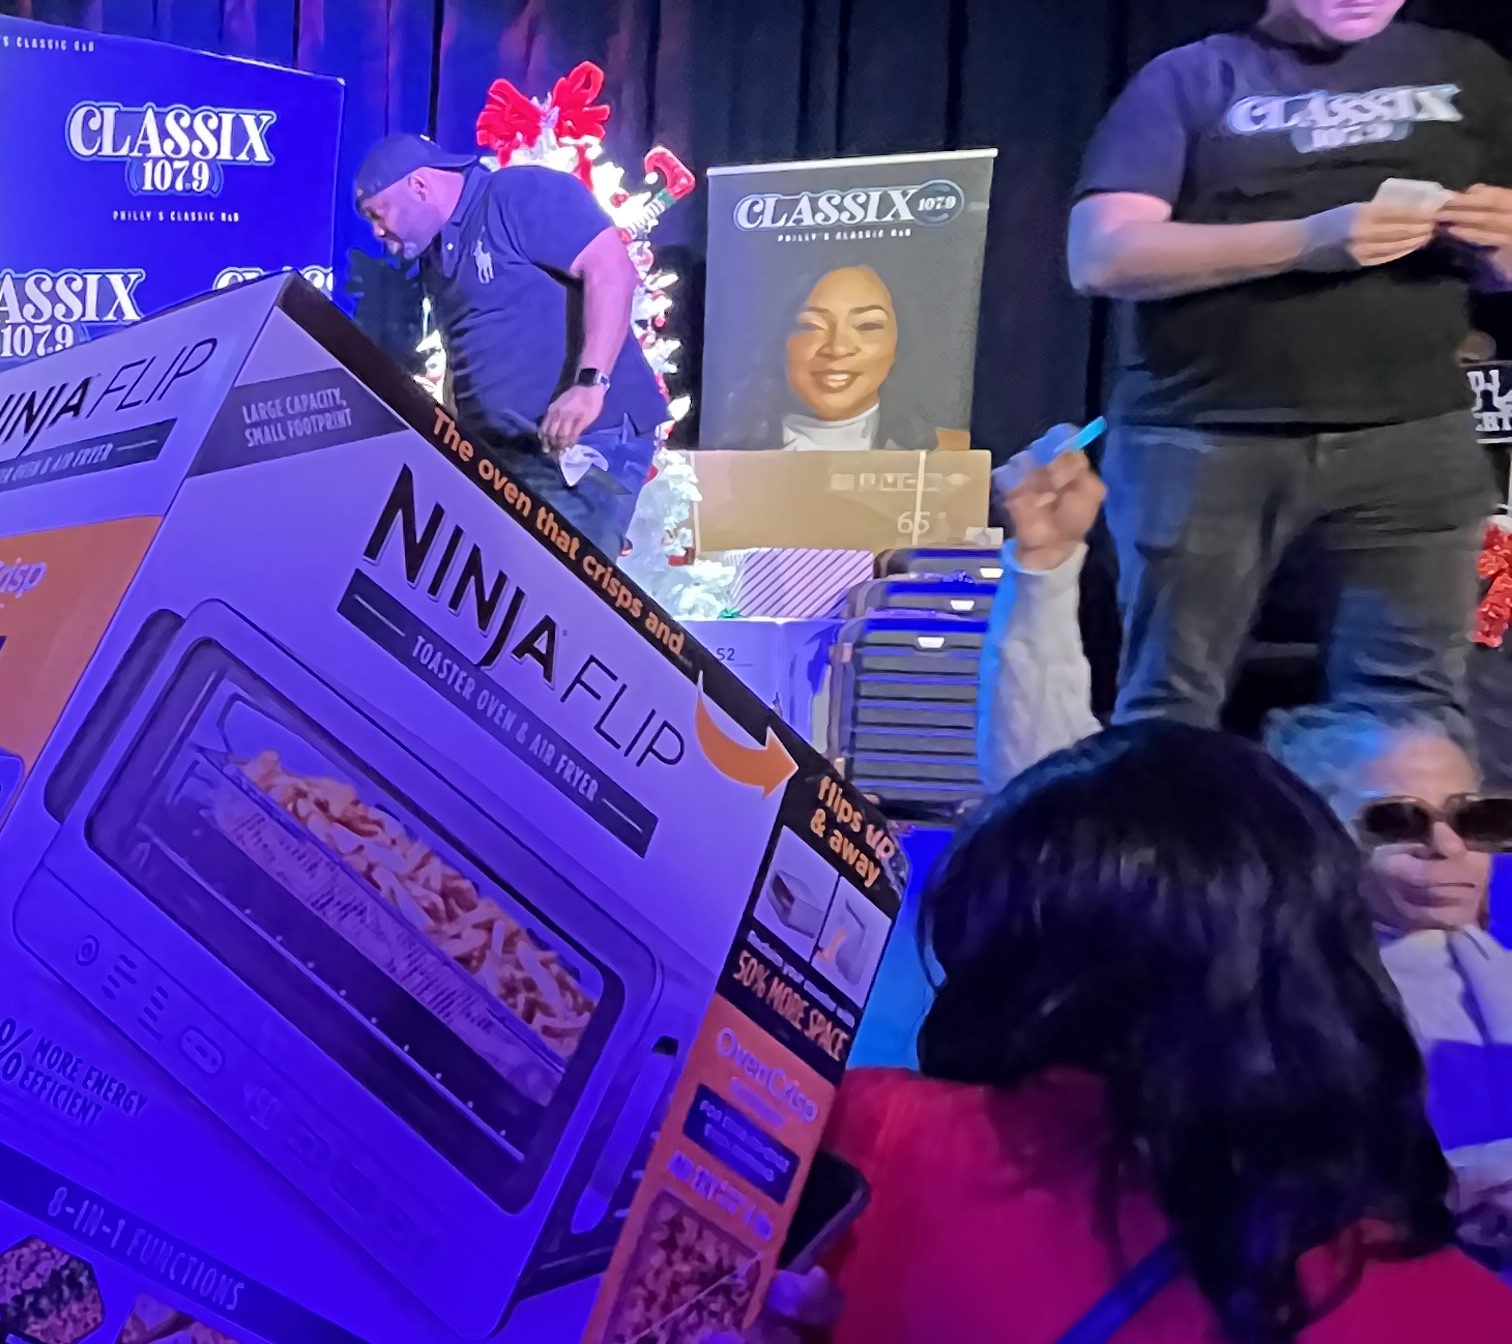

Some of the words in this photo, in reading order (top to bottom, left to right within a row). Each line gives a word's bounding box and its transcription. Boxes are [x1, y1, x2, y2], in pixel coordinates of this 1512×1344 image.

[69, 106, 273, 163] CLASSIX
[142, 158, 210, 193] 107.9
[737, 188, 918, 230] CLASSIX
[0, 323, 74, 358] 107.9
[86, 337, 218, 420] FLIP
[242, 399, 284, 424] LARGE
[286, 387, 347, 415] CAPACITY,
[244, 422, 286, 447] SMALL
[287, 407, 352, 439] FOOTPRINT
[433, 408, 474, 462] The
[478, 459, 532, 517] oven
[535, 505, 580, 561] that
[582, 555, 644, 618] crisps
[363, 463, 558, 689] NINJA
[560, 654, 686, 768] FLIP
[412, 635, 477, 702] TOASTER
[477, 688, 516, 732] OVEN
[515, 721, 529, 745] &
[529, 734, 557, 767] AIR
[555, 753, 599, 802] FRYER
[810, 807, 826, 839] &
[828, 828, 882, 888] away
[864, 823, 896, 860] up
[733, 949, 771, 998] 50%
[764, 975, 809, 1032] MORE
[803, 1011, 850, 1062] SPACE
[18, 1065, 104, 1126] EFFICIENT
[31, 1036, 84, 1083] MORE
[82, 1065, 149, 1118] ENERGY
[47, 1186, 126, 1249] 8-IN-1
[125, 1227, 245, 1311] FUNCTIONS
